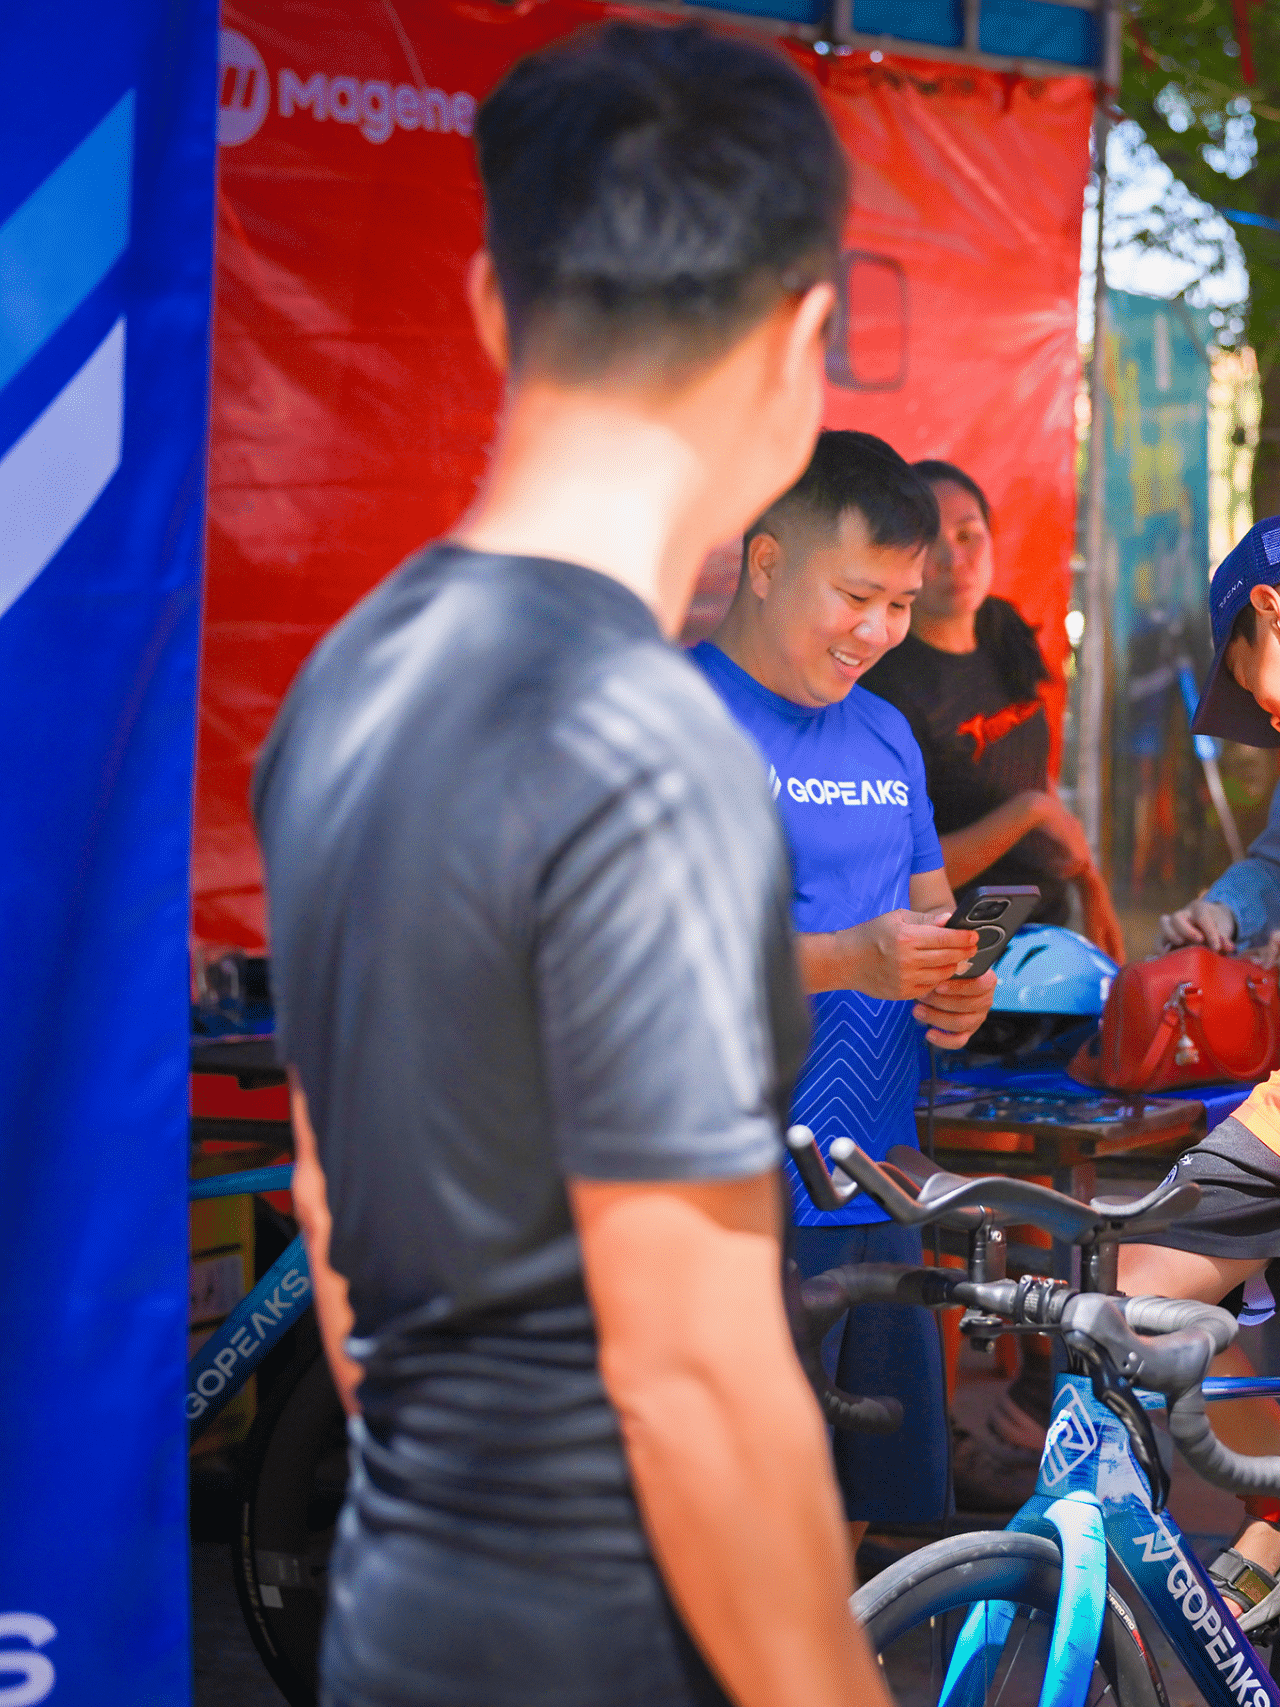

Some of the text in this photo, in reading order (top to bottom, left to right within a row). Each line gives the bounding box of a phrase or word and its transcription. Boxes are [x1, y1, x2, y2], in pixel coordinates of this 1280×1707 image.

[278, 68, 476, 144] Magene
[787, 777, 909, 806] GOPEAKS
[186, 1268, 311, 1419] GOPEAKS
